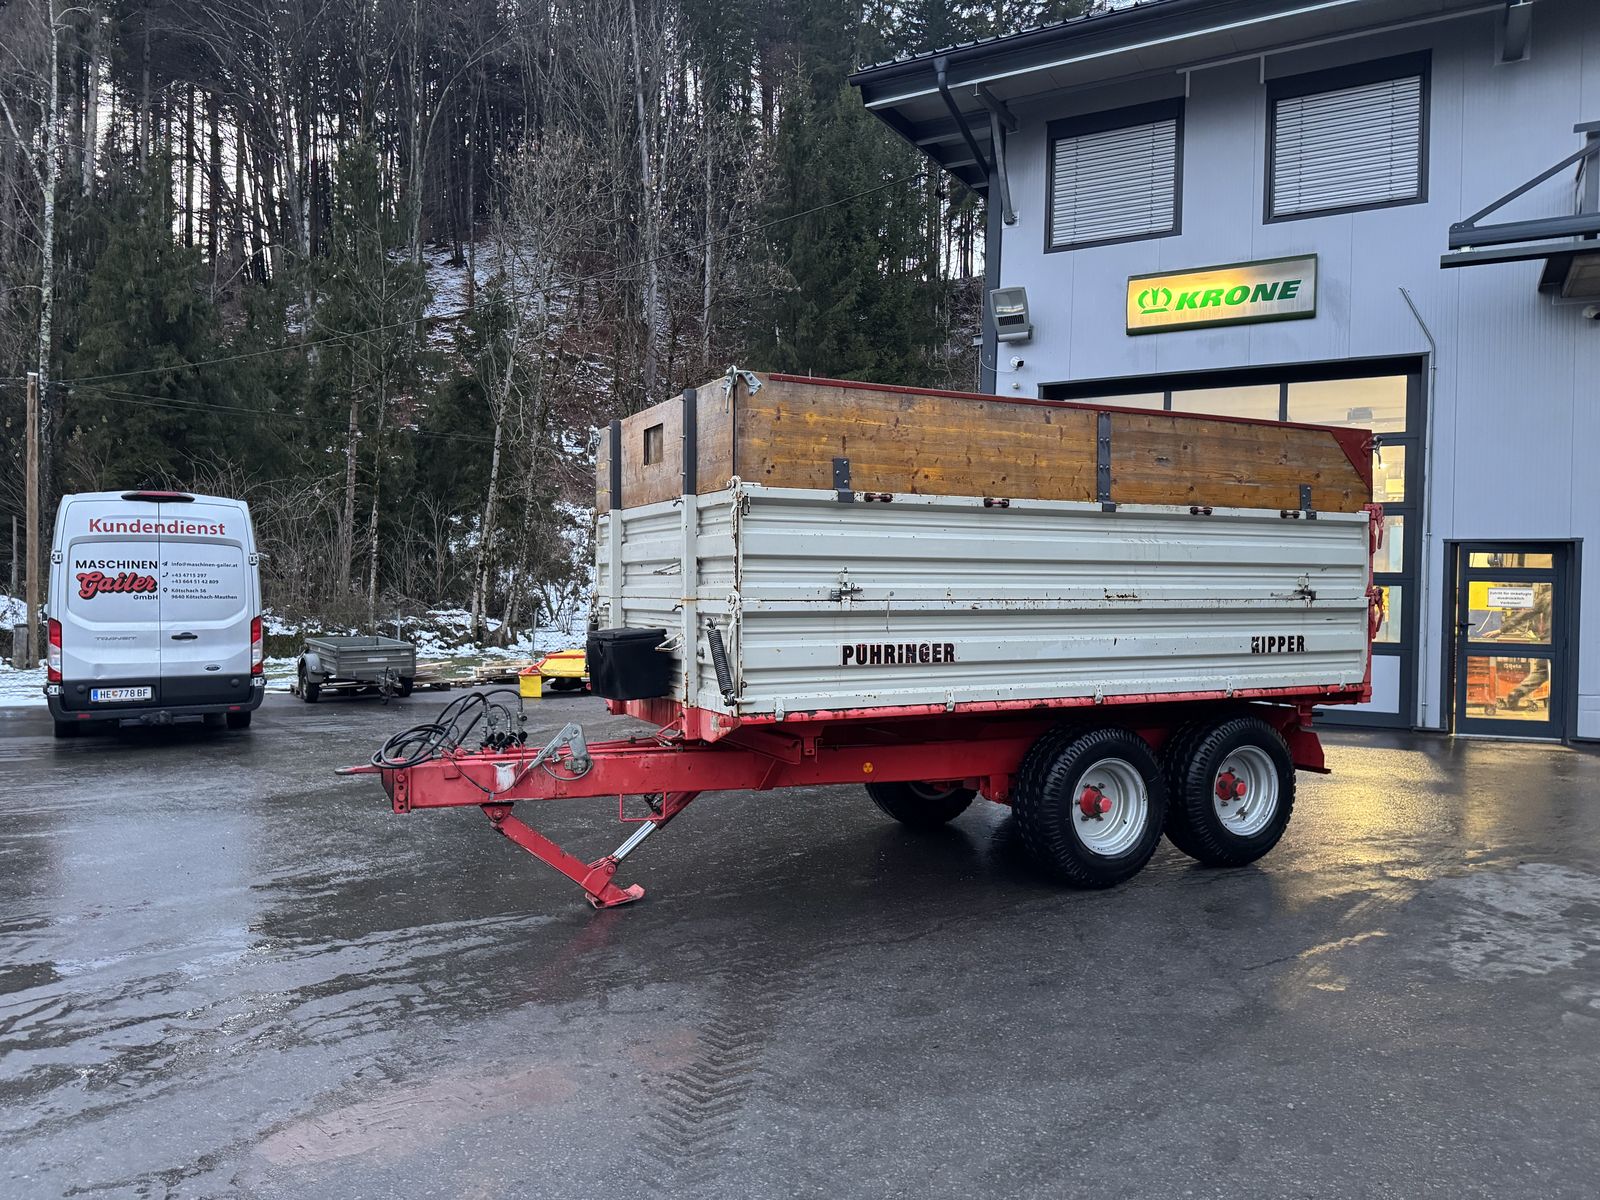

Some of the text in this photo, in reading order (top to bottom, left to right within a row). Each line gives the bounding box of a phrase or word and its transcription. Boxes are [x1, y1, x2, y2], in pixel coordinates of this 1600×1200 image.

[1175, 279, 1302, 311] KRONE
[89, 518, 226, 535] Kundendienst
[75, 559, 158, 570] MASCHINEN
[76, 571, 158, 600] Gailer
[1251, 635, 1305, 654] KIPPER
[100, 688, 148, 699] HE 778 BF
